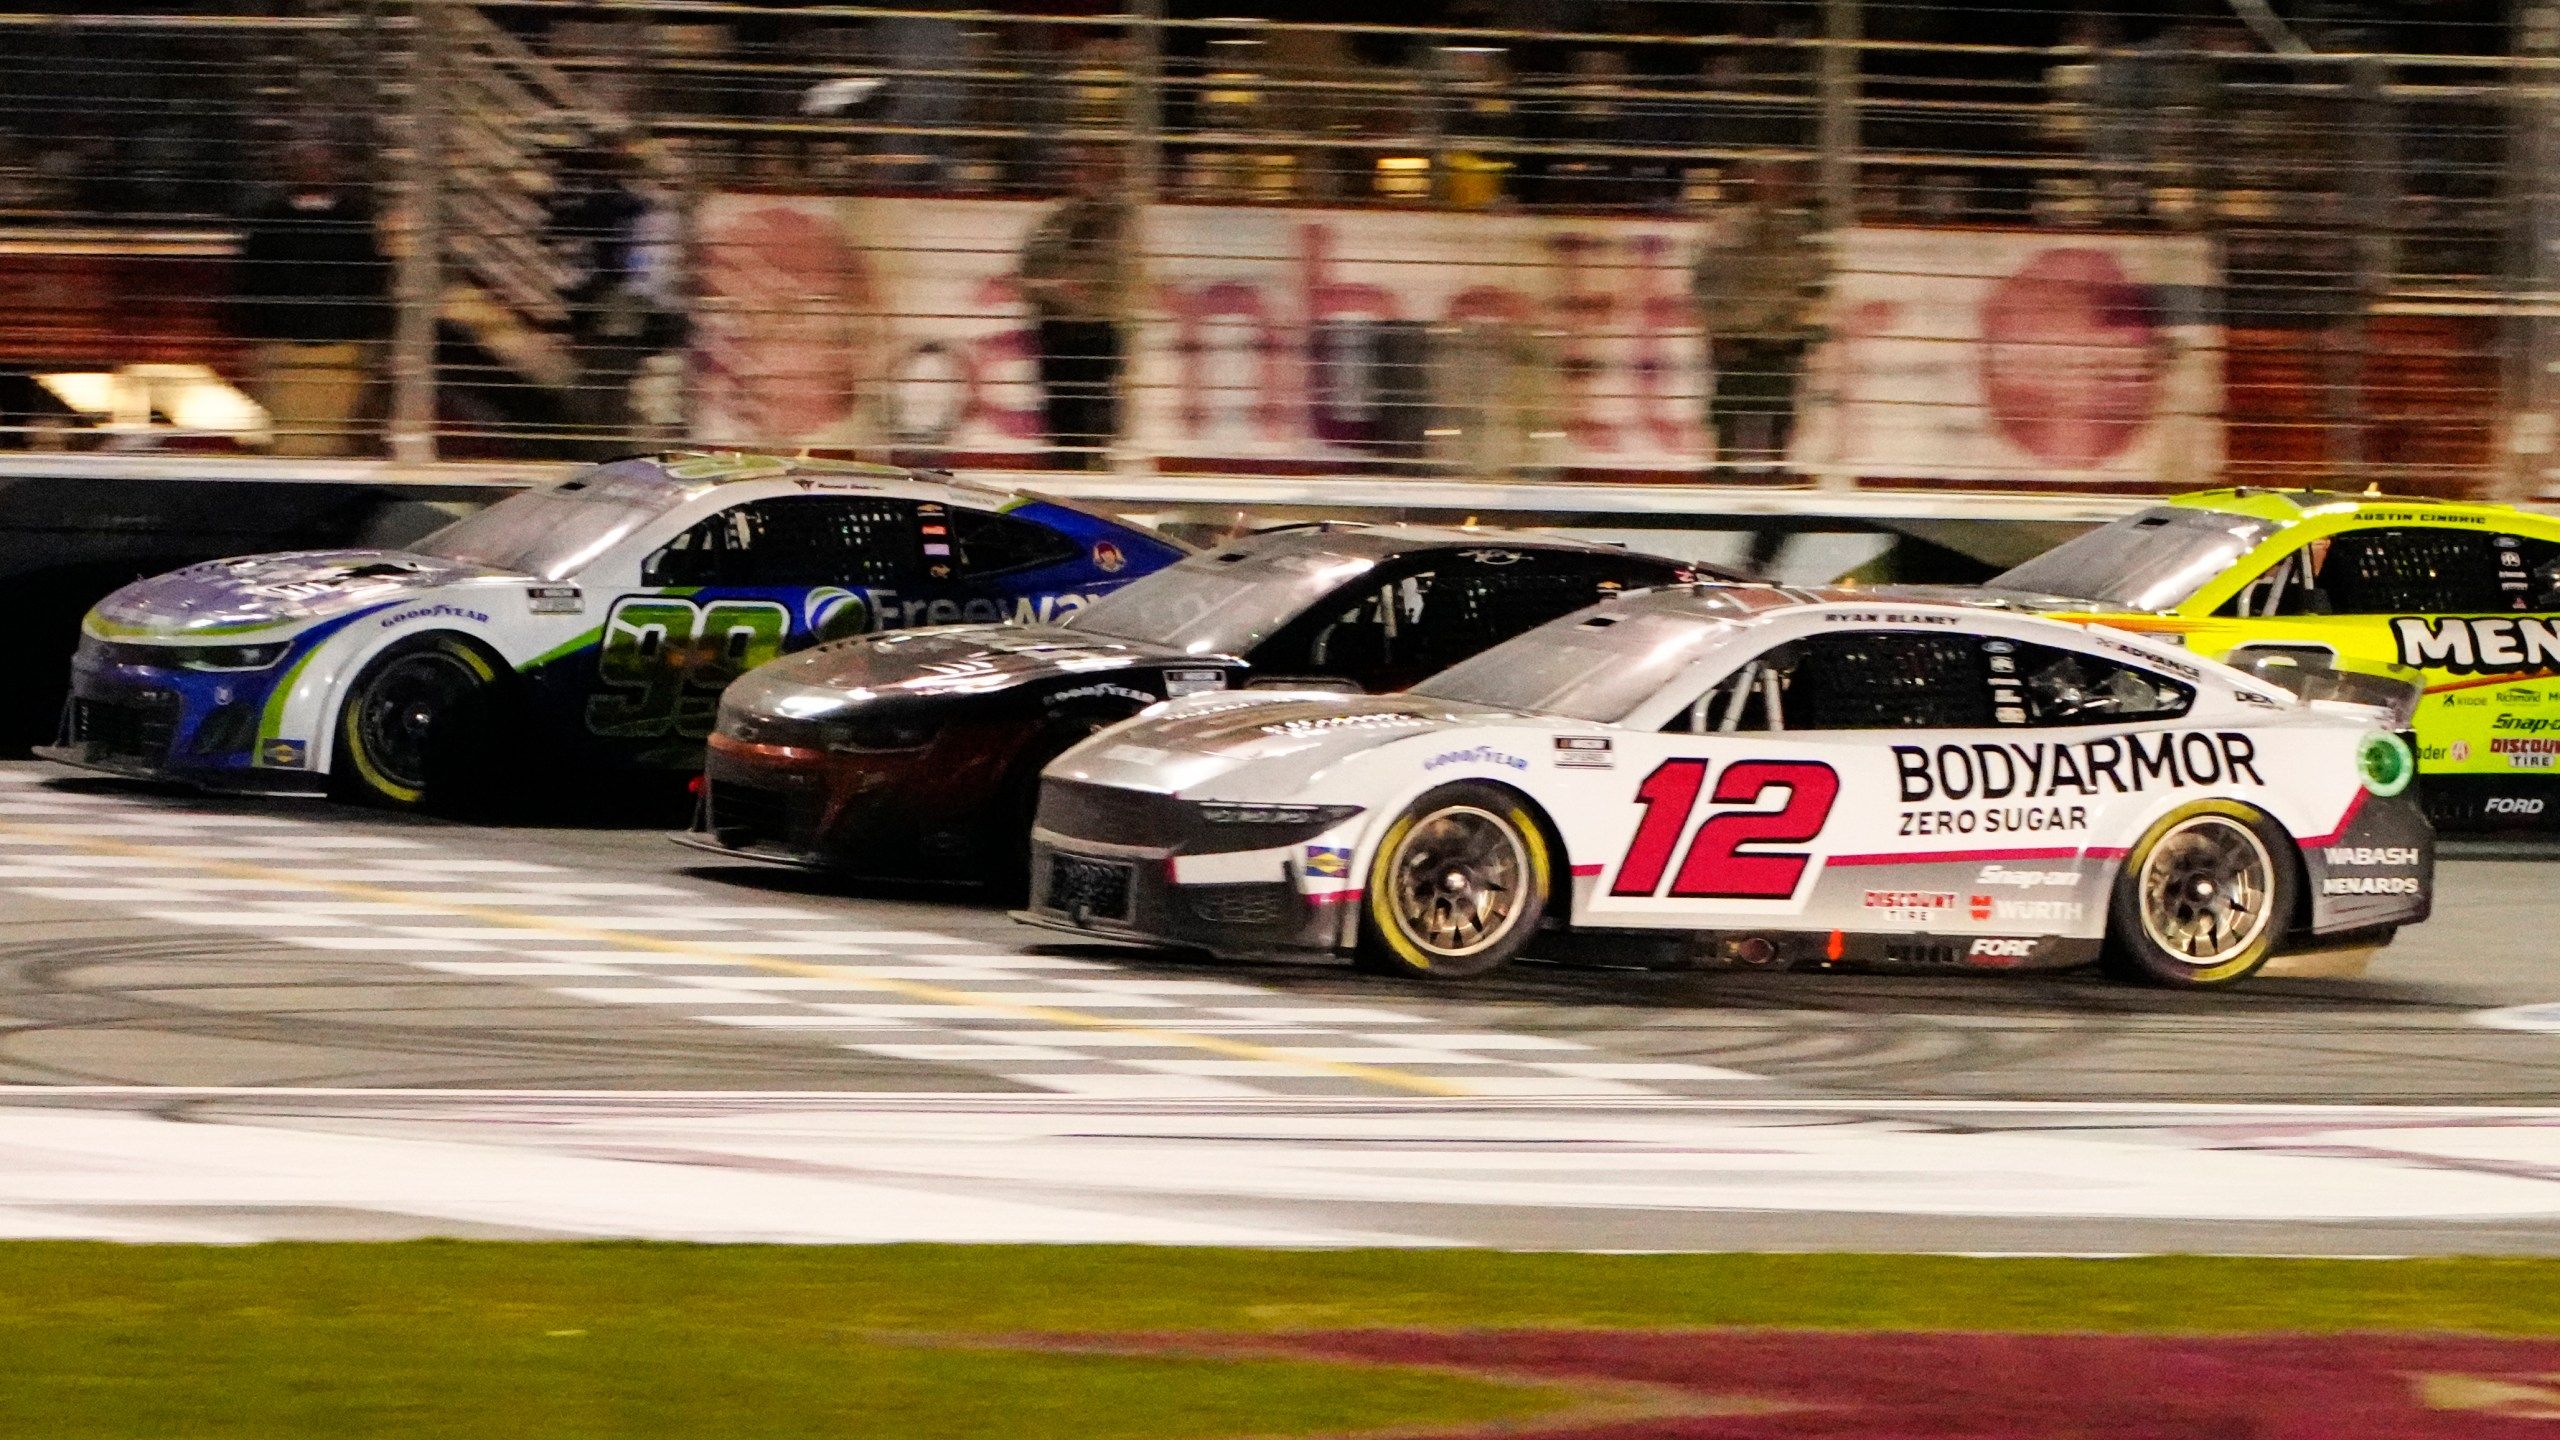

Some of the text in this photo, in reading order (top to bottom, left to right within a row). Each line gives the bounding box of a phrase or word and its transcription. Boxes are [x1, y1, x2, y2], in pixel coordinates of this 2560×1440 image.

[2353, 513, 2486, 524] AUSTIN CINDRIC
[380, 603, 490, 628] GOODYEAR
[867, 588, 1103, 631] Freewa
[1825, 613, 1961, 625] RYAN BLANEY
[1424, 746, 1529, 771] GOODYEAR
[1891, 732, 2265, 802] BODYARMOR
[2484, 798, 2546, 813] FORD
[1609, 757, 1841, 900] 12
[1899, 806, 2088, 836] ZERO SUGAR
[2323, 847, 2420, 865] WABASH
[2323, 877, 2419, 894] MENARDS
